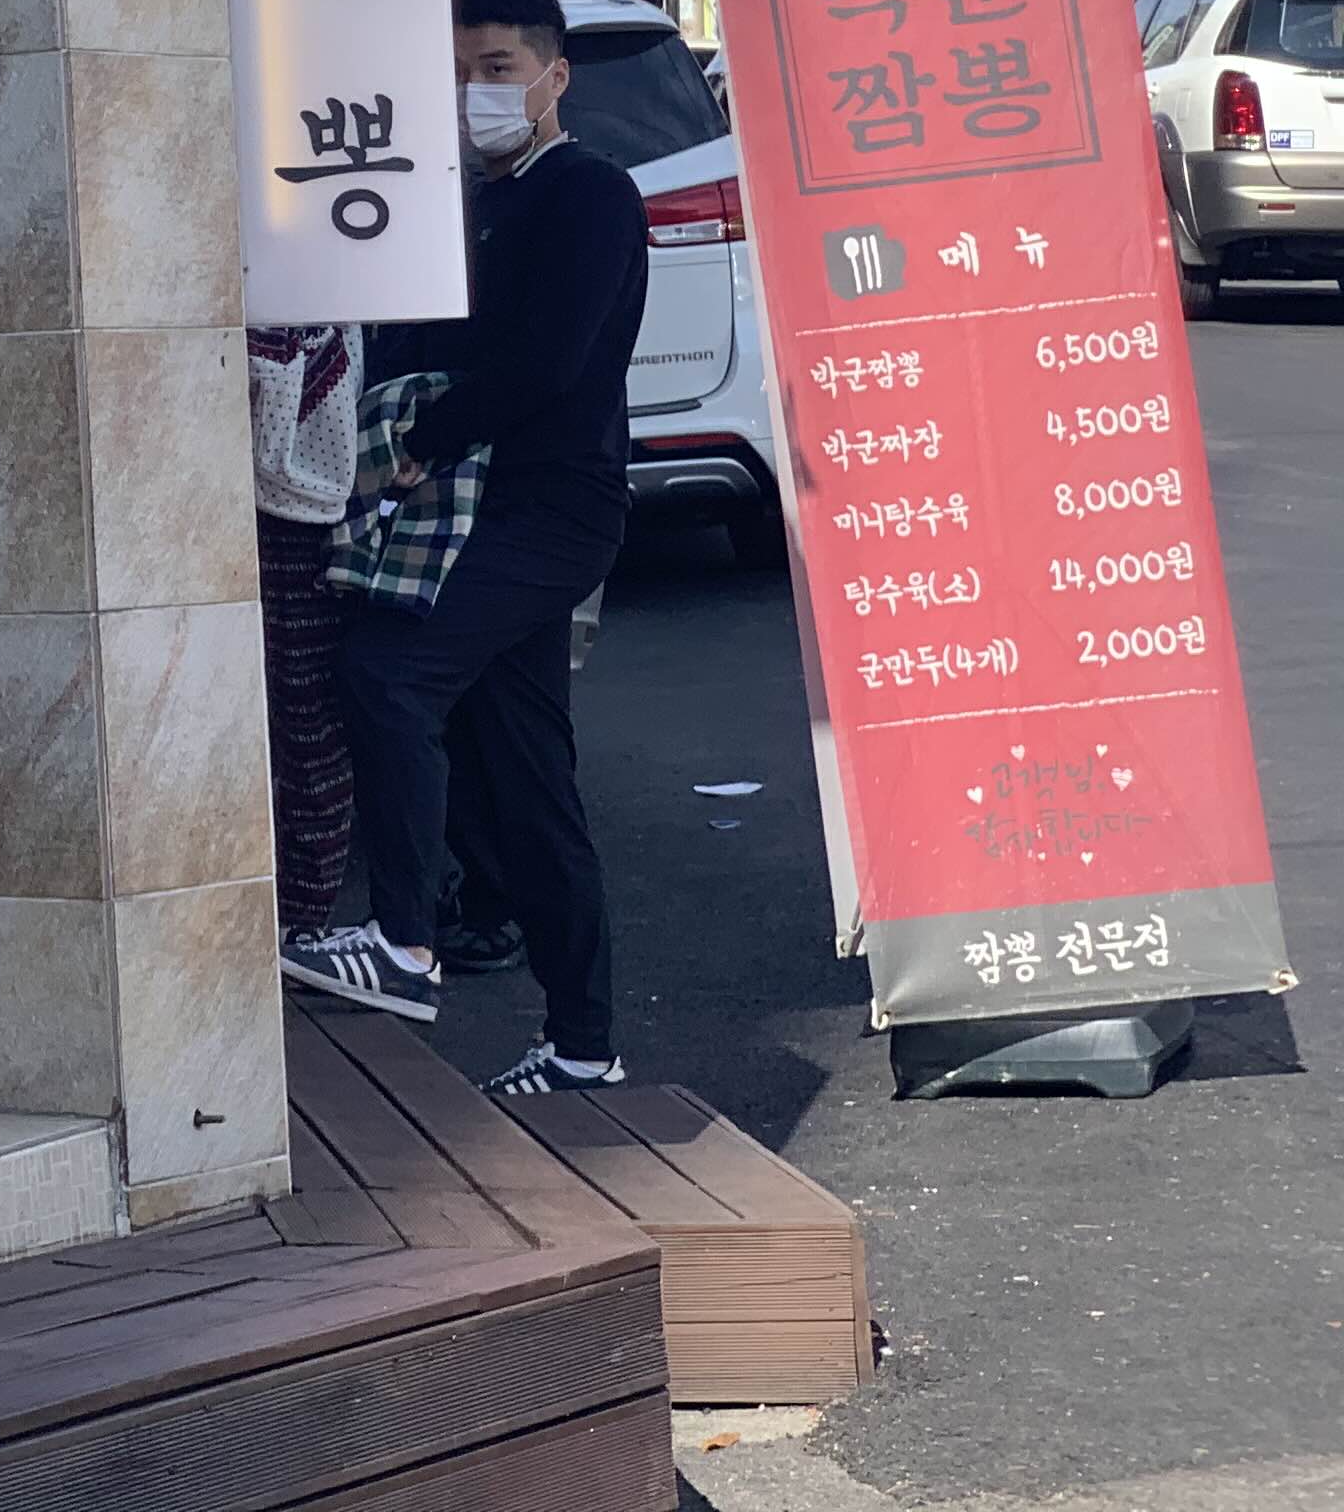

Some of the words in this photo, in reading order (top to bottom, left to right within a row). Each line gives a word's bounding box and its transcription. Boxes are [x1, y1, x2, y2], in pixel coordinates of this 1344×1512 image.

[827, 38, 1052, 154] 짬뽕
[1270, 132, 1290, 143] DPF
[937, 226, 1050, 276] 메뉴
[810, 349, 925, 399] 박군짬뽕
[1034, 320, 1160, 373] 6,500원
[821, 420, 944, 472] 박군짜장
[1045, 394, 1171, 445] 4,500원
[832, 492, 970, 540] 미니탕수육
[1053, 467, 1183, 519] 8,000원
[843, 566, 982, 616] 탕수육(소)
[1048, 541, 1195, 594] 14,000원
[856, 637, 1019, 689] 군만두(4개)
[1076, 615, 1207, 667] 2,000원
[963, 931, 1043, 985] 짬뽕
[1056, 913, 1170, 977] 전문점
